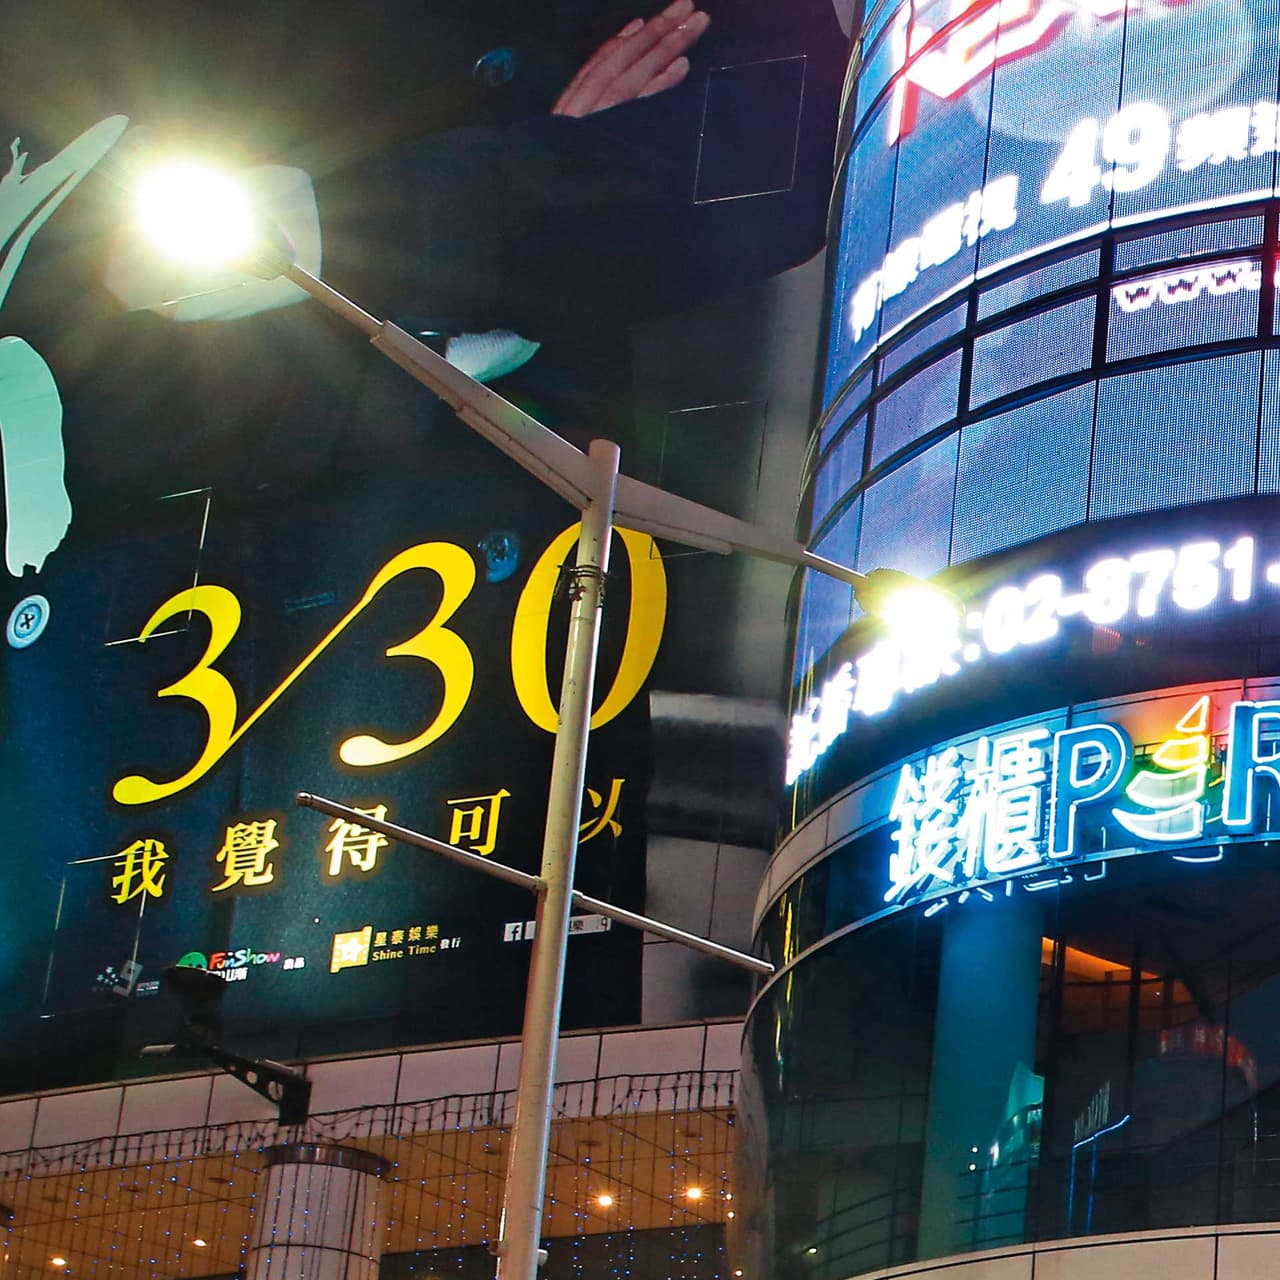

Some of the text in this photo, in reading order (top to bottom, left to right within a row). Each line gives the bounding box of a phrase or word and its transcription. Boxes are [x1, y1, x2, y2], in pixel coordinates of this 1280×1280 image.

[112, 521, 668, 806] 3/30
[372, 944, 437, 962] Shine Time
